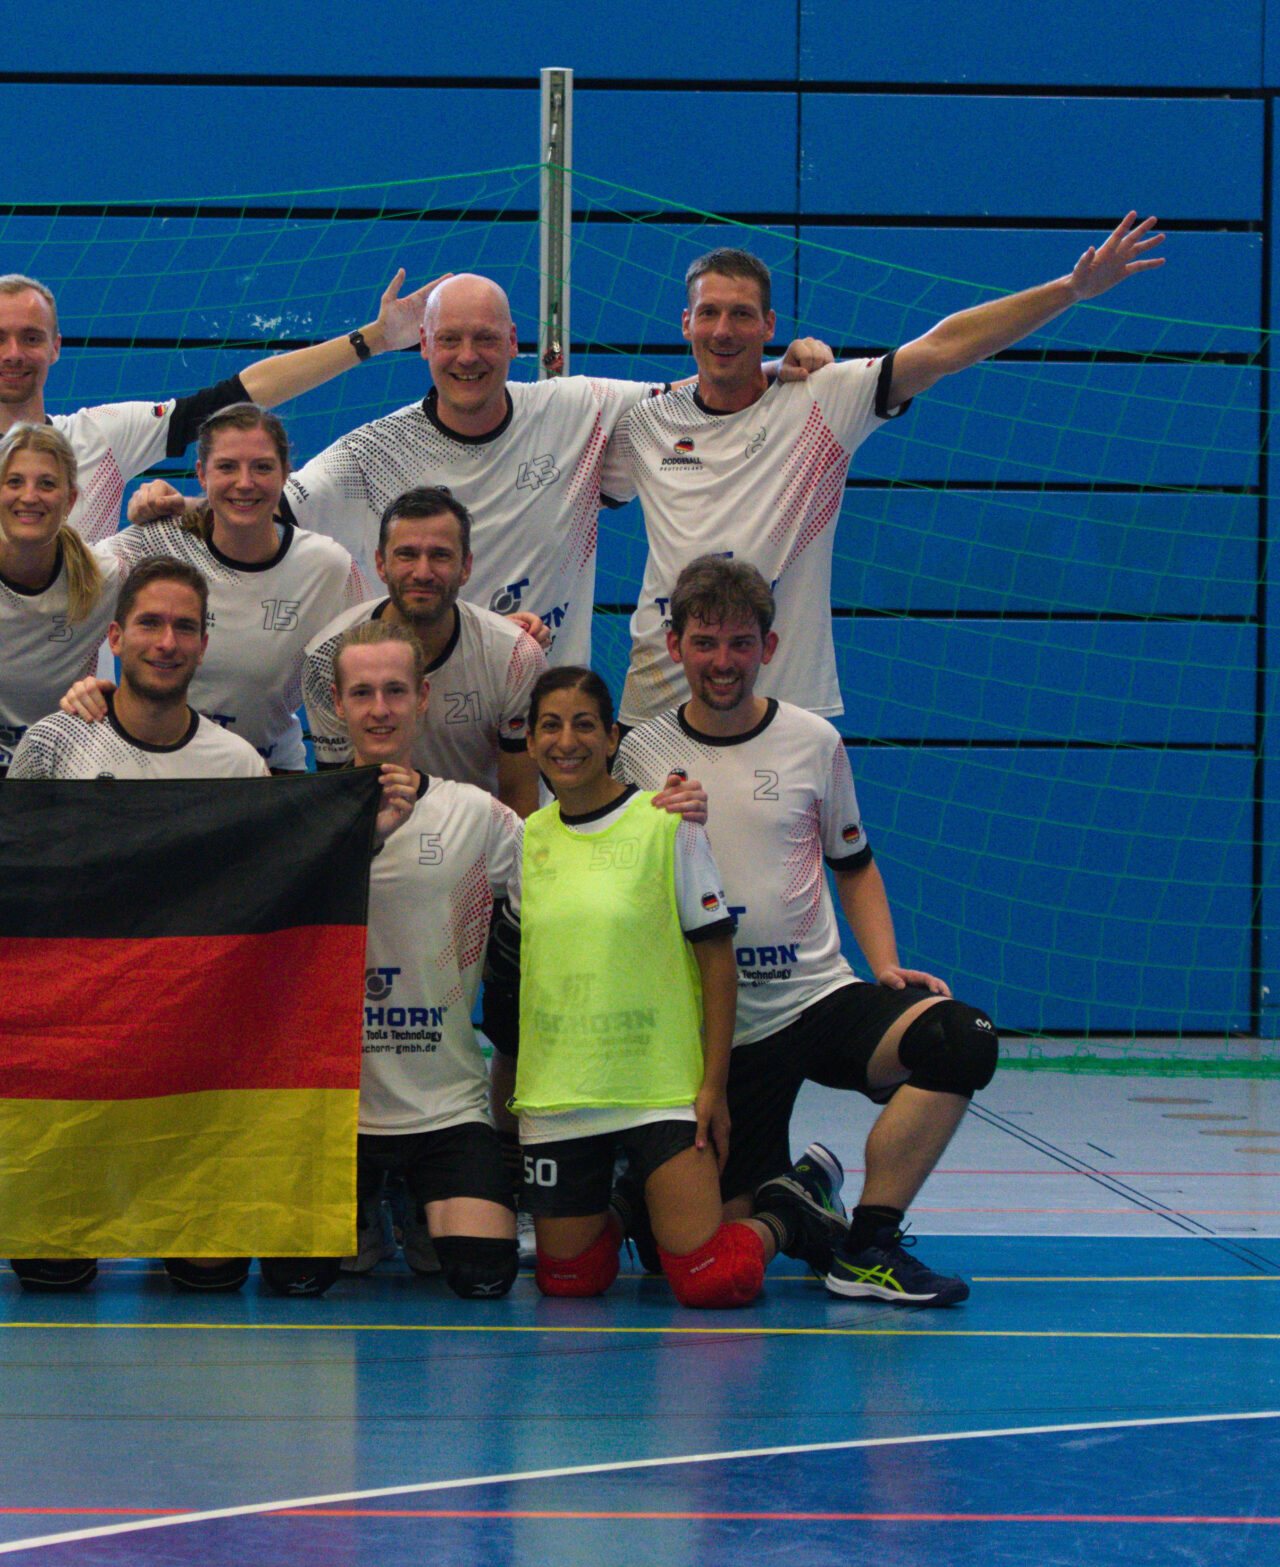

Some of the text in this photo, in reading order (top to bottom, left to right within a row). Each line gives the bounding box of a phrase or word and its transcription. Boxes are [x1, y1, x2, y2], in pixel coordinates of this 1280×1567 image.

[516, 453, 560, 491] 43
[261, 599, 300, 631] 15
[444, 690, 481, 724] 21
[753, 770, 779, 801] 2
[418, 833, 444, 865] 5
[589, 837, 641, 871] 50
[741, 968, 792, 980] Technology
[363, 1006, 443, 1027] HORN
[361, 1044, 437, 1054] schorn-gmbh.de
[366, 1029, 442, 1042] Tools Technology
[523, 1156, 558, 1187] 50
